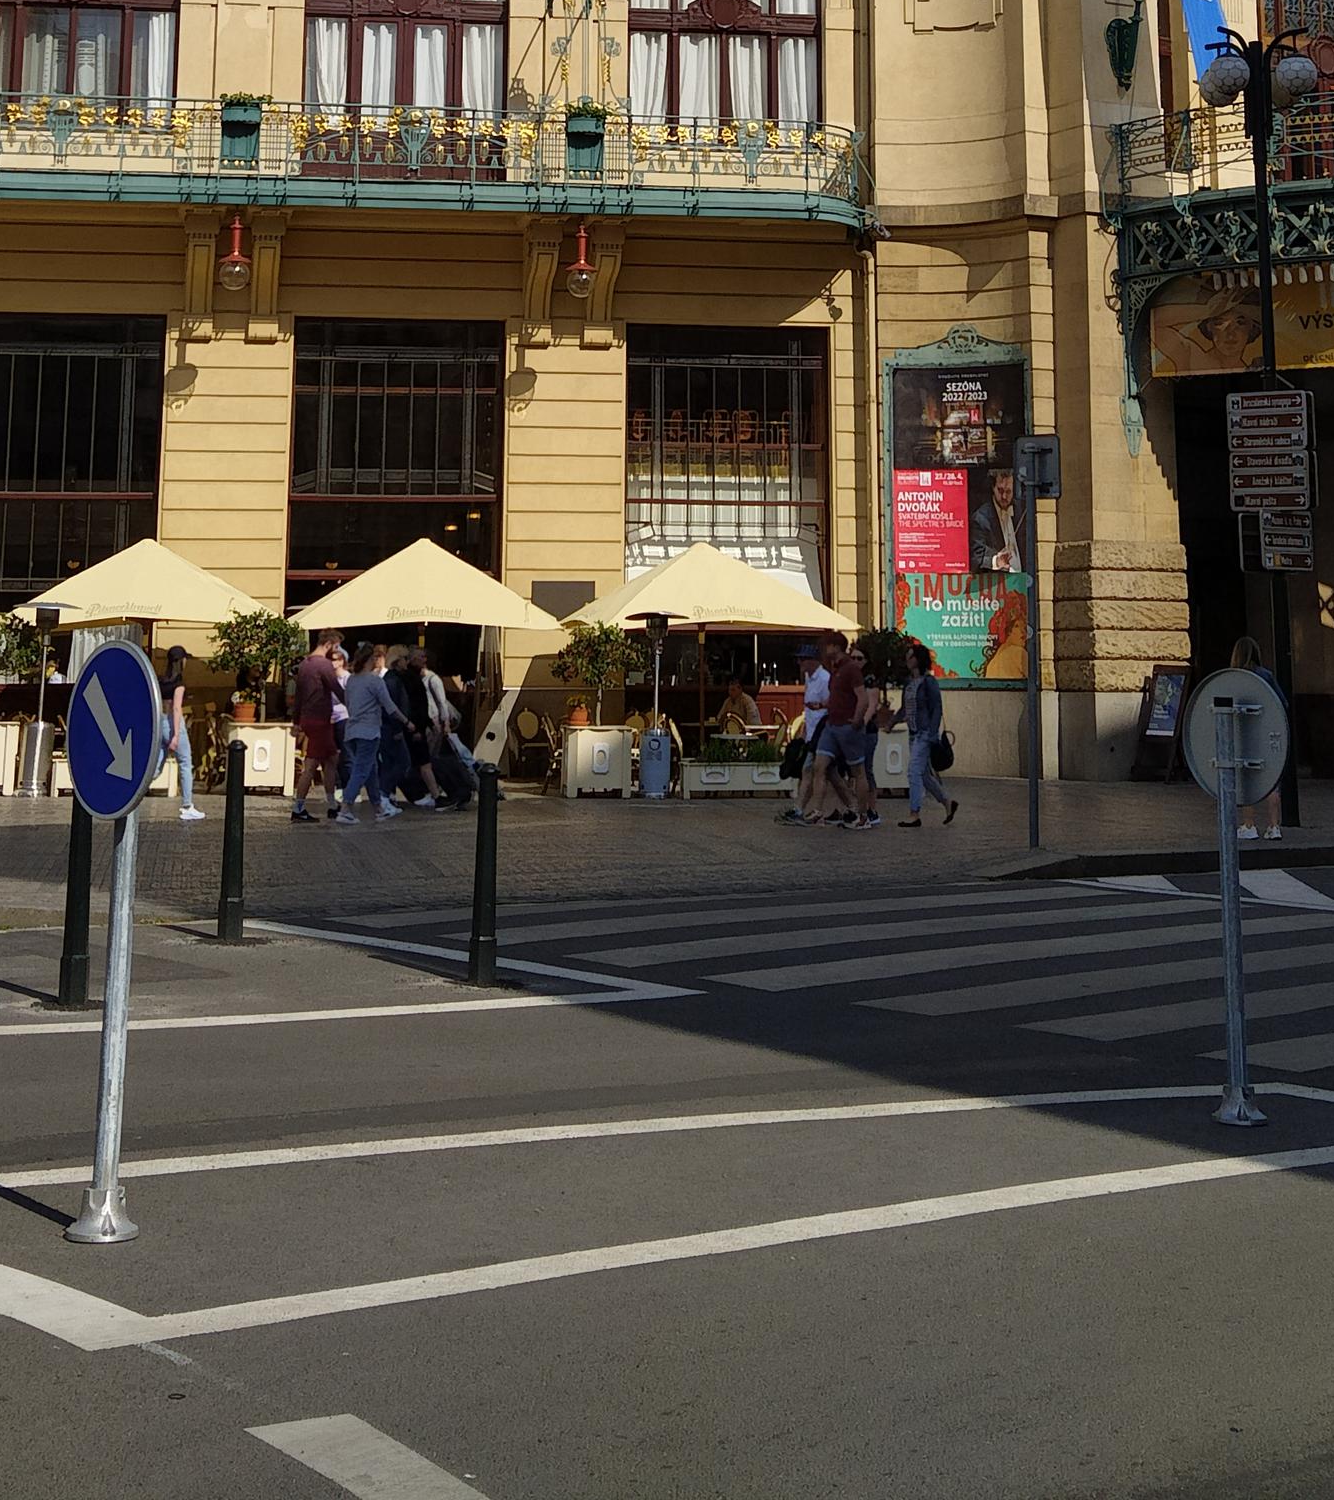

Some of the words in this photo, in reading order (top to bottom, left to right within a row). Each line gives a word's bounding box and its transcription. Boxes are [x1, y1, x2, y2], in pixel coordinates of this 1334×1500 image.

[945, 380, 982, 392] SEZÓNA
[941, 392, 988, 402] 2022/2023
[897, 490, 944, 502] ANTONÍN
[897, 502, 940, 512] DVOŘÁK
[898, 520, 911, 528] THE
[922, 596, 943, 611] To
[946, 595, 1000, 612] musíte
[941, 612, 985, 628] zažít!
